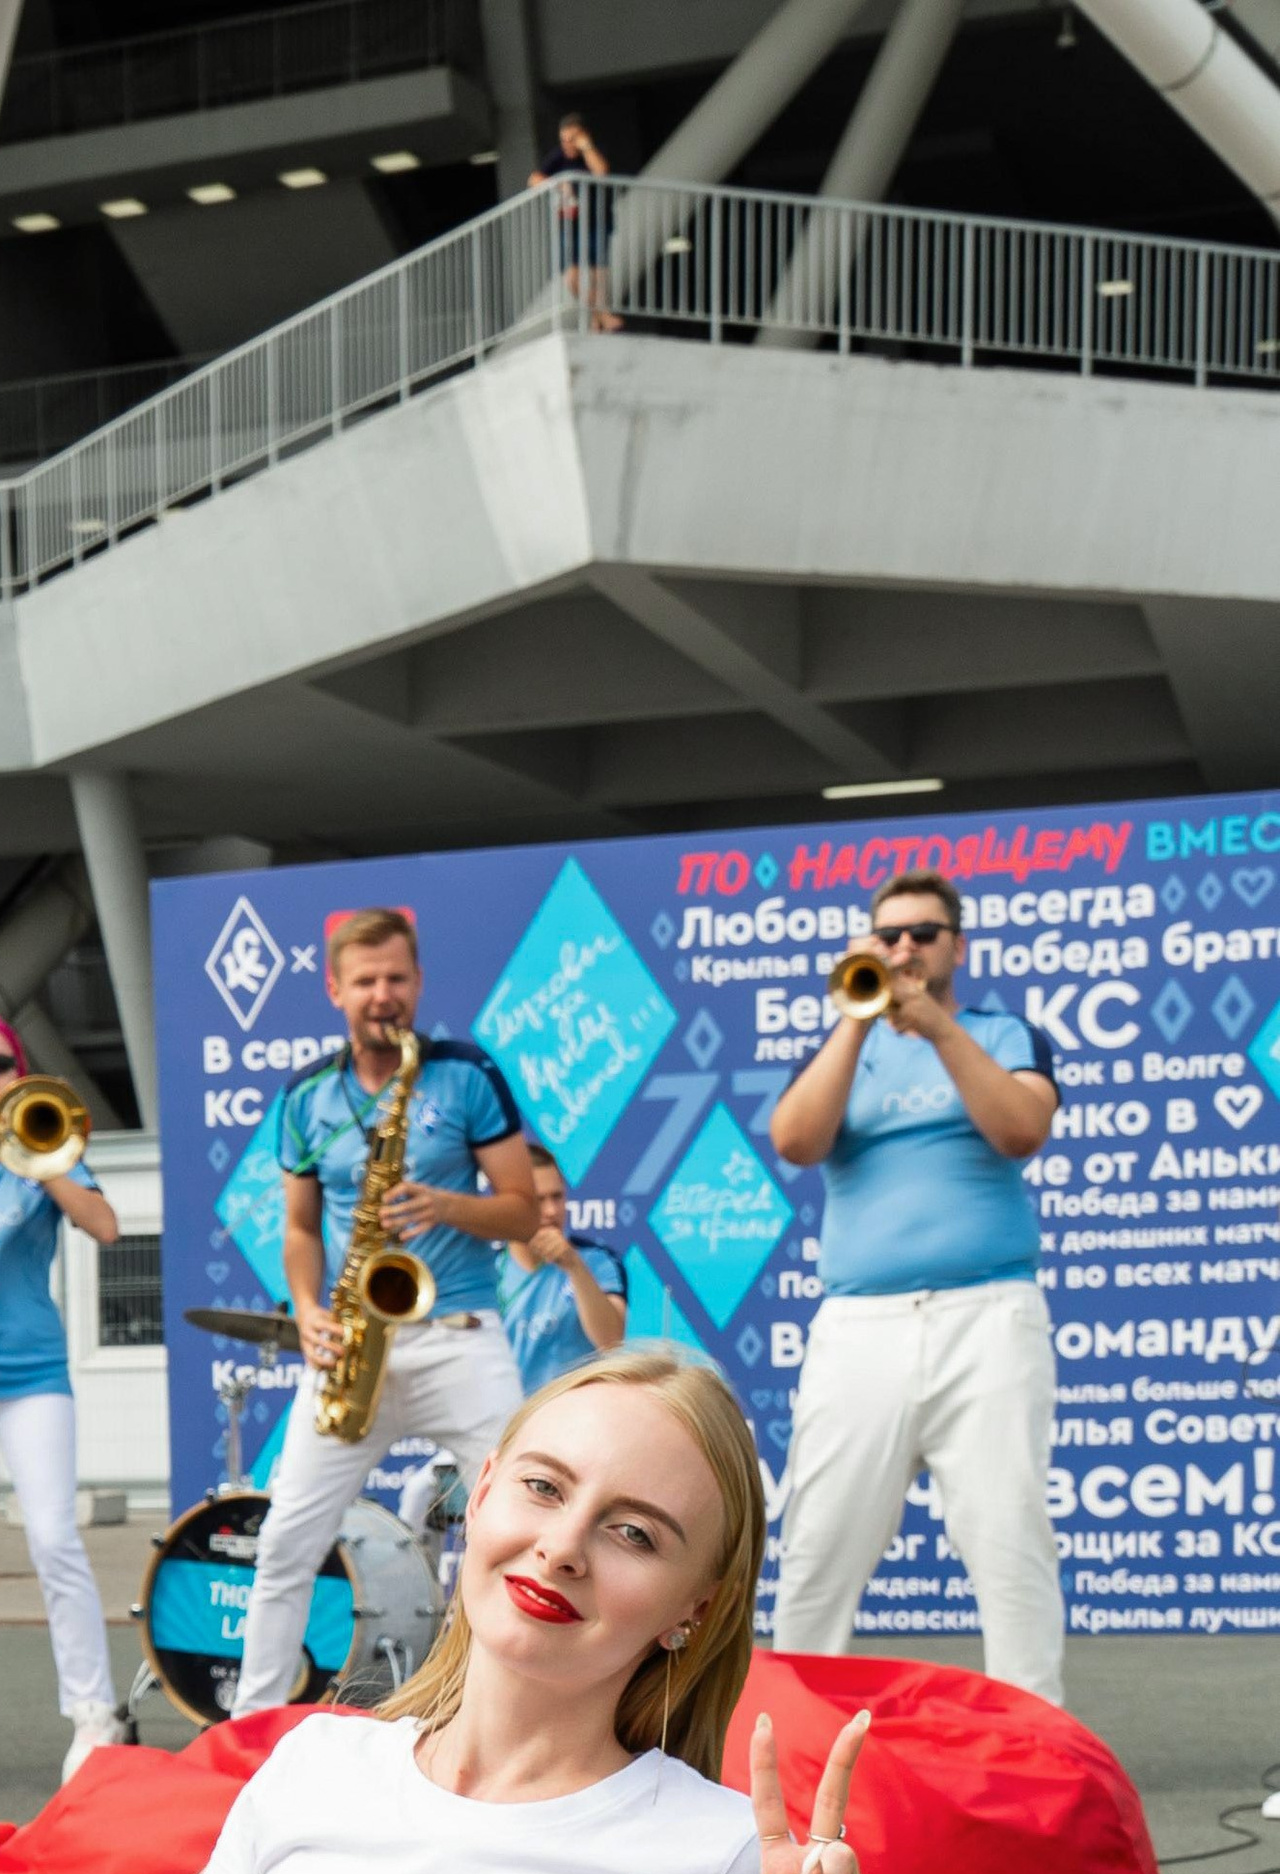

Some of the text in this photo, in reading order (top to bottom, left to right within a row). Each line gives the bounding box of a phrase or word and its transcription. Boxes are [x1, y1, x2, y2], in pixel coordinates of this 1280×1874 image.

[677, 851, 750, 896] ПО
[788, 821, 1133, 890] НАСТОЯЩЕМУ
[677, 896, 872, 949] Любовь
[690, 954, 809, 987] Крылья
[969, 929, 1149, 980] Победа
[1025, 979, 1141, 1050] КС
[203, 1035, 233, 1075] В
[1142, 1051, 1246, 1082] Волге
[204, 1087, 265, 1128] КС
[1083, 1151, 1139, 1184] от
[1040, 1186, 1159, 1218] Победа
[1166, 1189, 1201, 1212] за
[1060, 1225, 1208, 1256] домашних
[1065, 1265, 1107, 1289] во
[1115, 1262, 1193, 1288] всех
[1049, 1315, 1280, 1366] оманду
[1132, 1375, 1238, 1402] больше
[1046, 1447, 1276, 1519] всем!
[1175, 1529, 1221, 1558] за
[1074, 1567, 1178, 1598] Победа
[1184, 1572, 1215, 1594] за
[1070, 1604, 1183, 1634] Крылья
